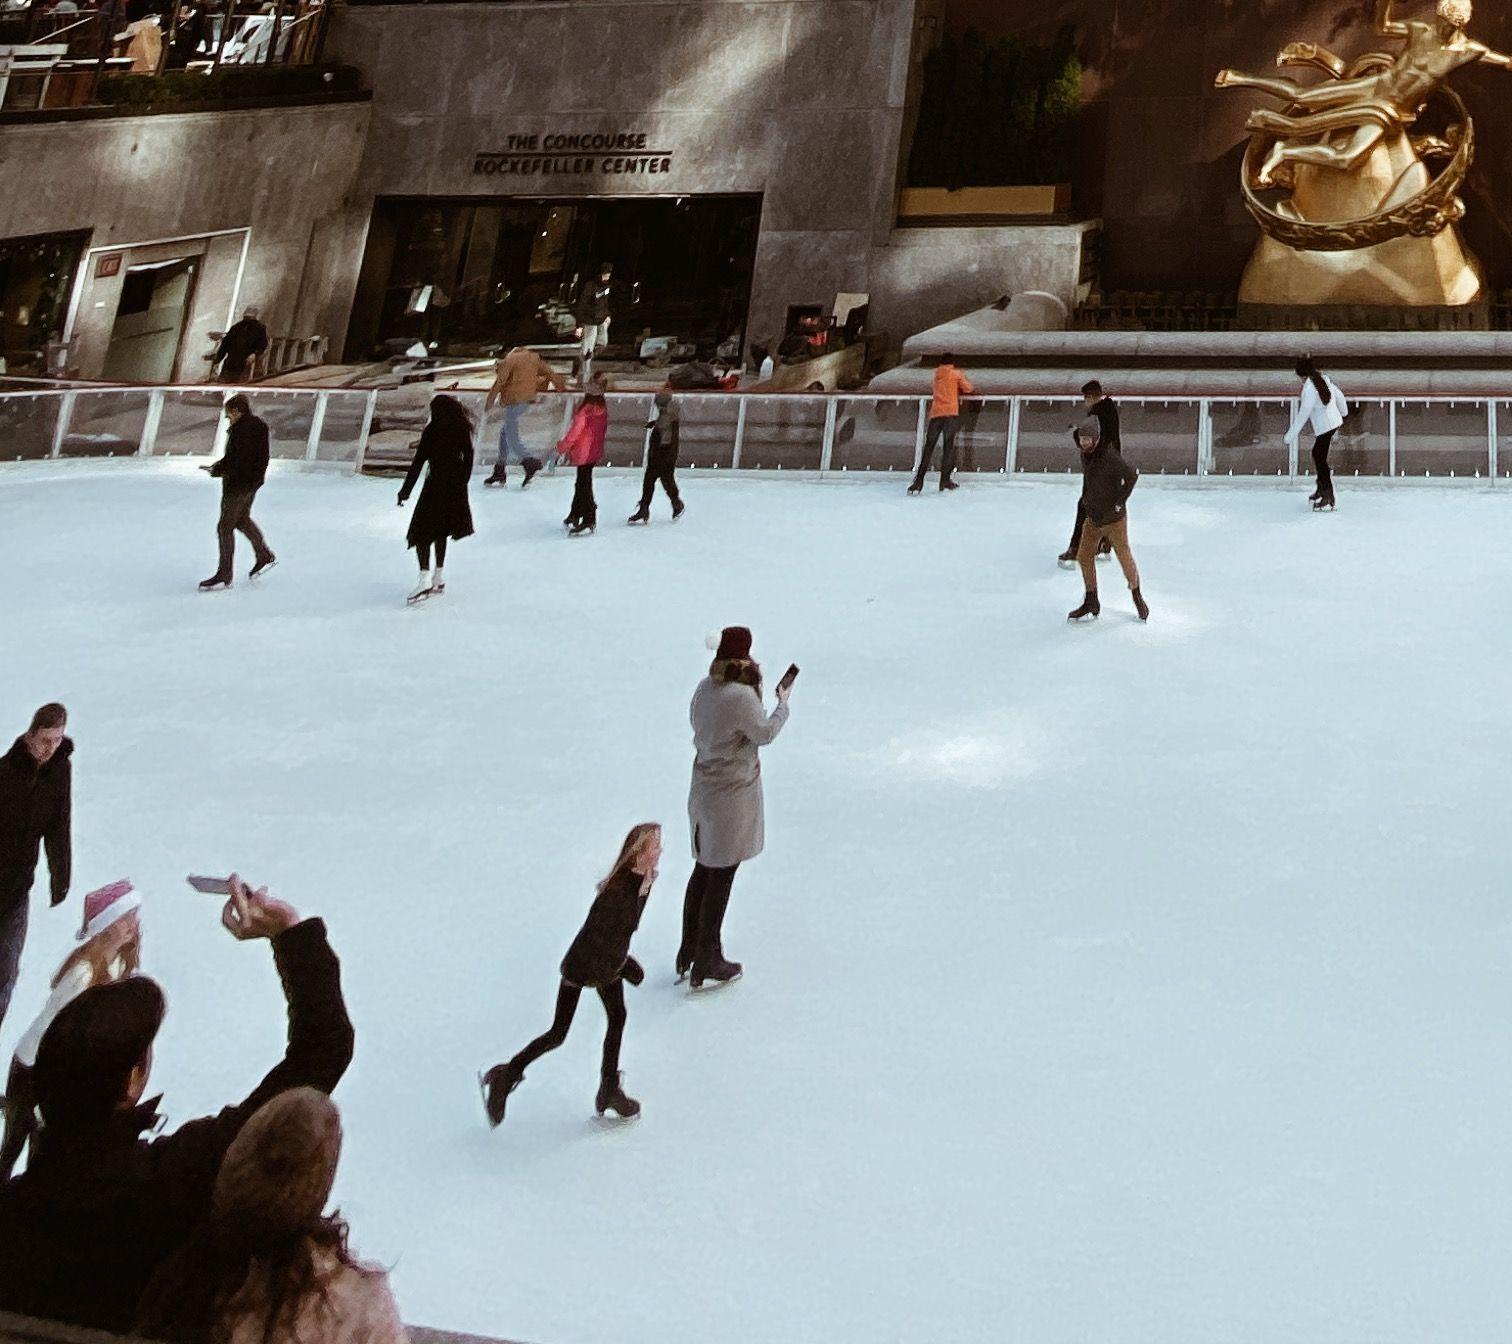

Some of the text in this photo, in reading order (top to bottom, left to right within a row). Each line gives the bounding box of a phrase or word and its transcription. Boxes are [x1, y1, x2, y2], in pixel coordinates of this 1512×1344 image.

[507, 132, 648, 150] THE CONCOURSE
[472, 156, 672, 176] ROCKEFELLER CENTER
